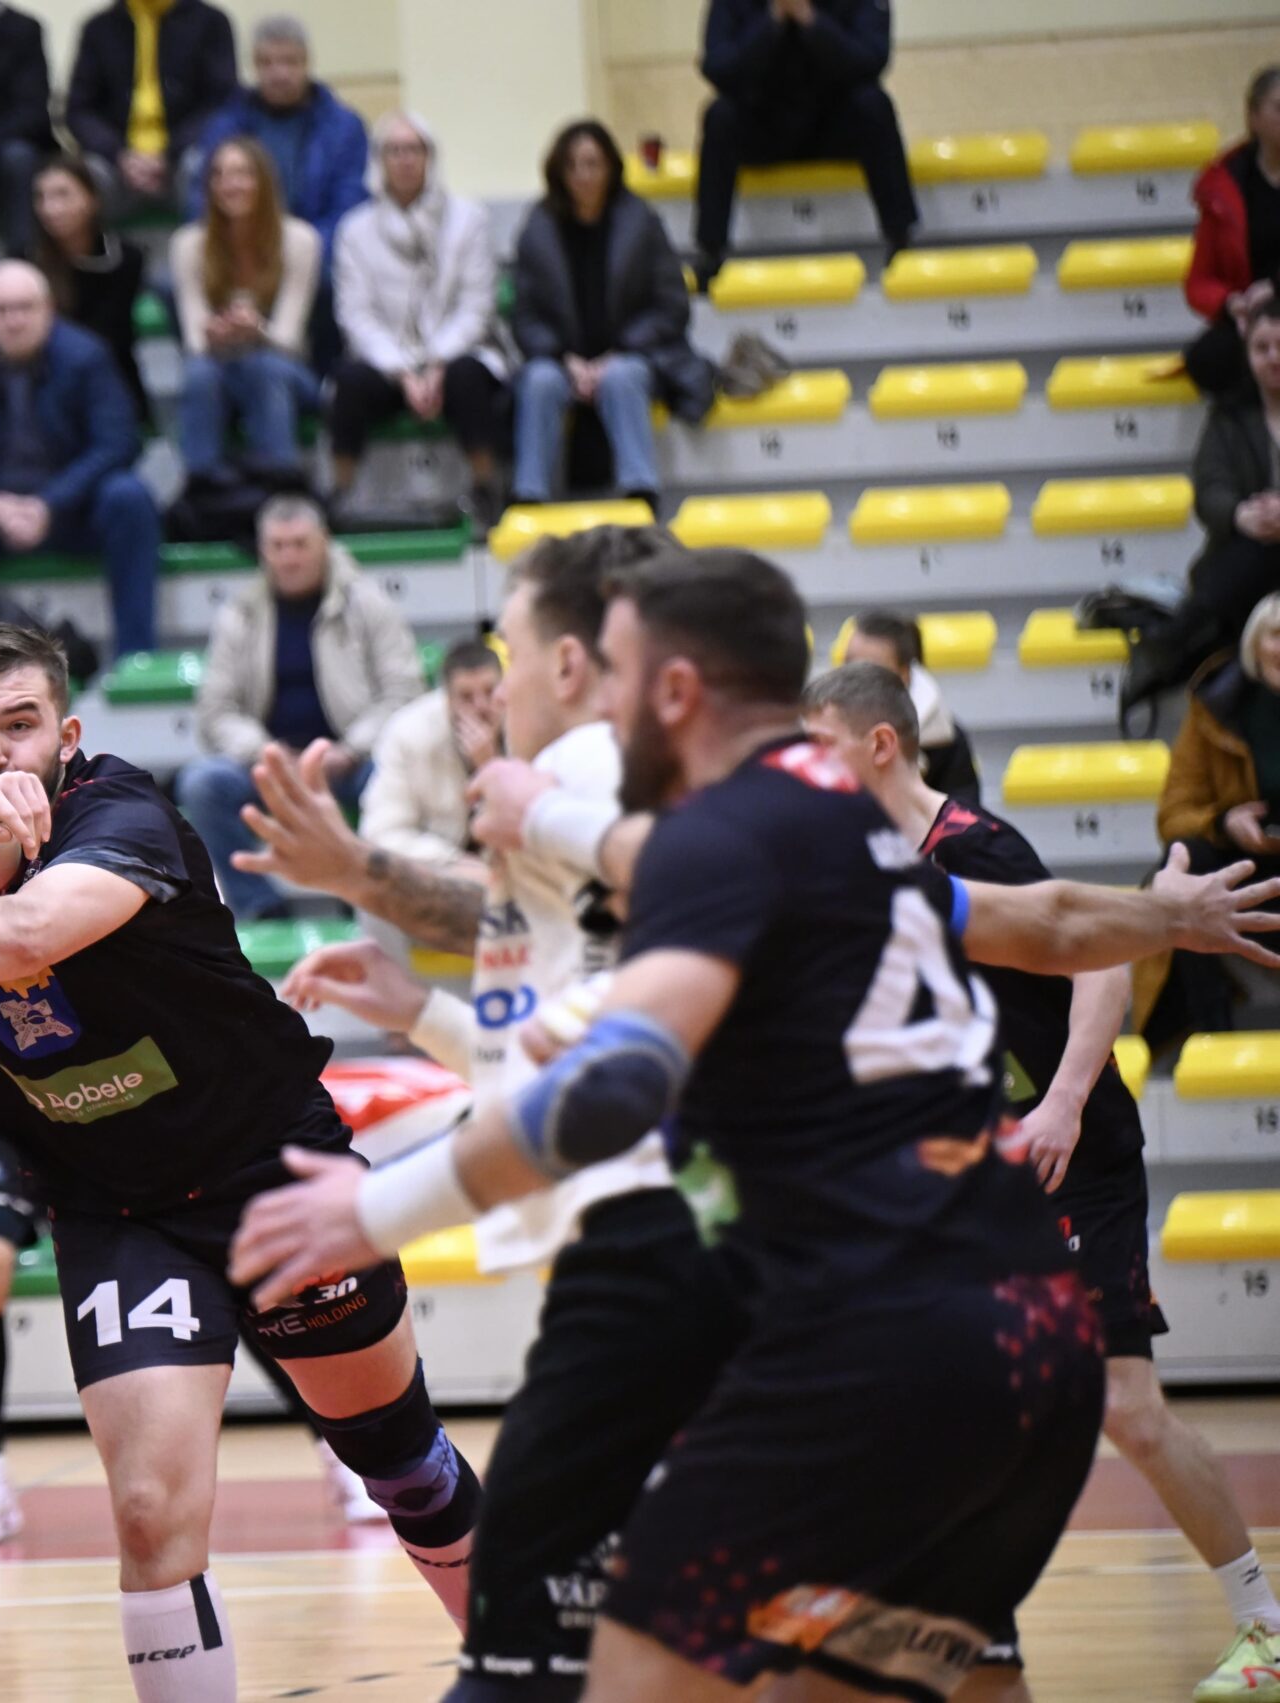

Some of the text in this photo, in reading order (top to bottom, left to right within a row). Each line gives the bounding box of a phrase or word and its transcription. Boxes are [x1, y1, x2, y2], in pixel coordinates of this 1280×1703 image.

[77, 1278, 200, 1347] 14
[306, 1293, 369, 1330] HOLDING
[147, 1643, 197, 1663] cep
